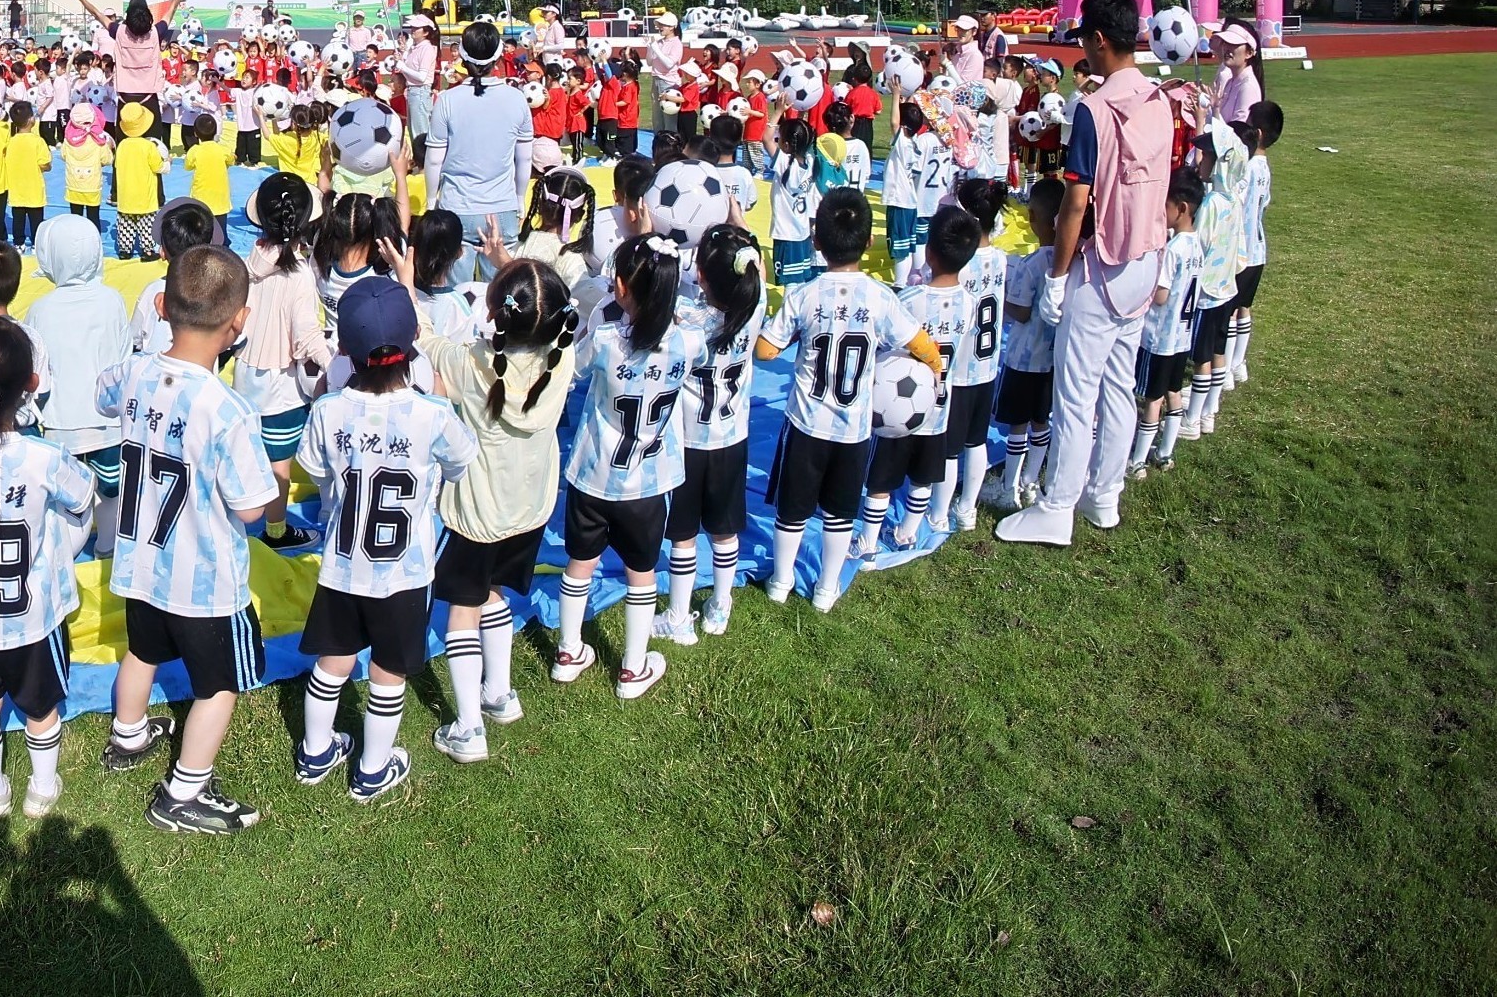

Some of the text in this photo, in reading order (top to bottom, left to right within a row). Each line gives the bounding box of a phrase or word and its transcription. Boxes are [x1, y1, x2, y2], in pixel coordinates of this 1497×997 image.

[1048, 153, 1056, 164] 13
[973, 293, 1000, 362] 8
[1179, 275, 1199, 333] 4
[616, 360, 686, 381] 孙雨彤
[808, 331, 872, 409] 10
[334, 429, 413, 458] 郭沈燃
[116, 439, 191, 551] 17
[335, 465, 418, 563] 16
